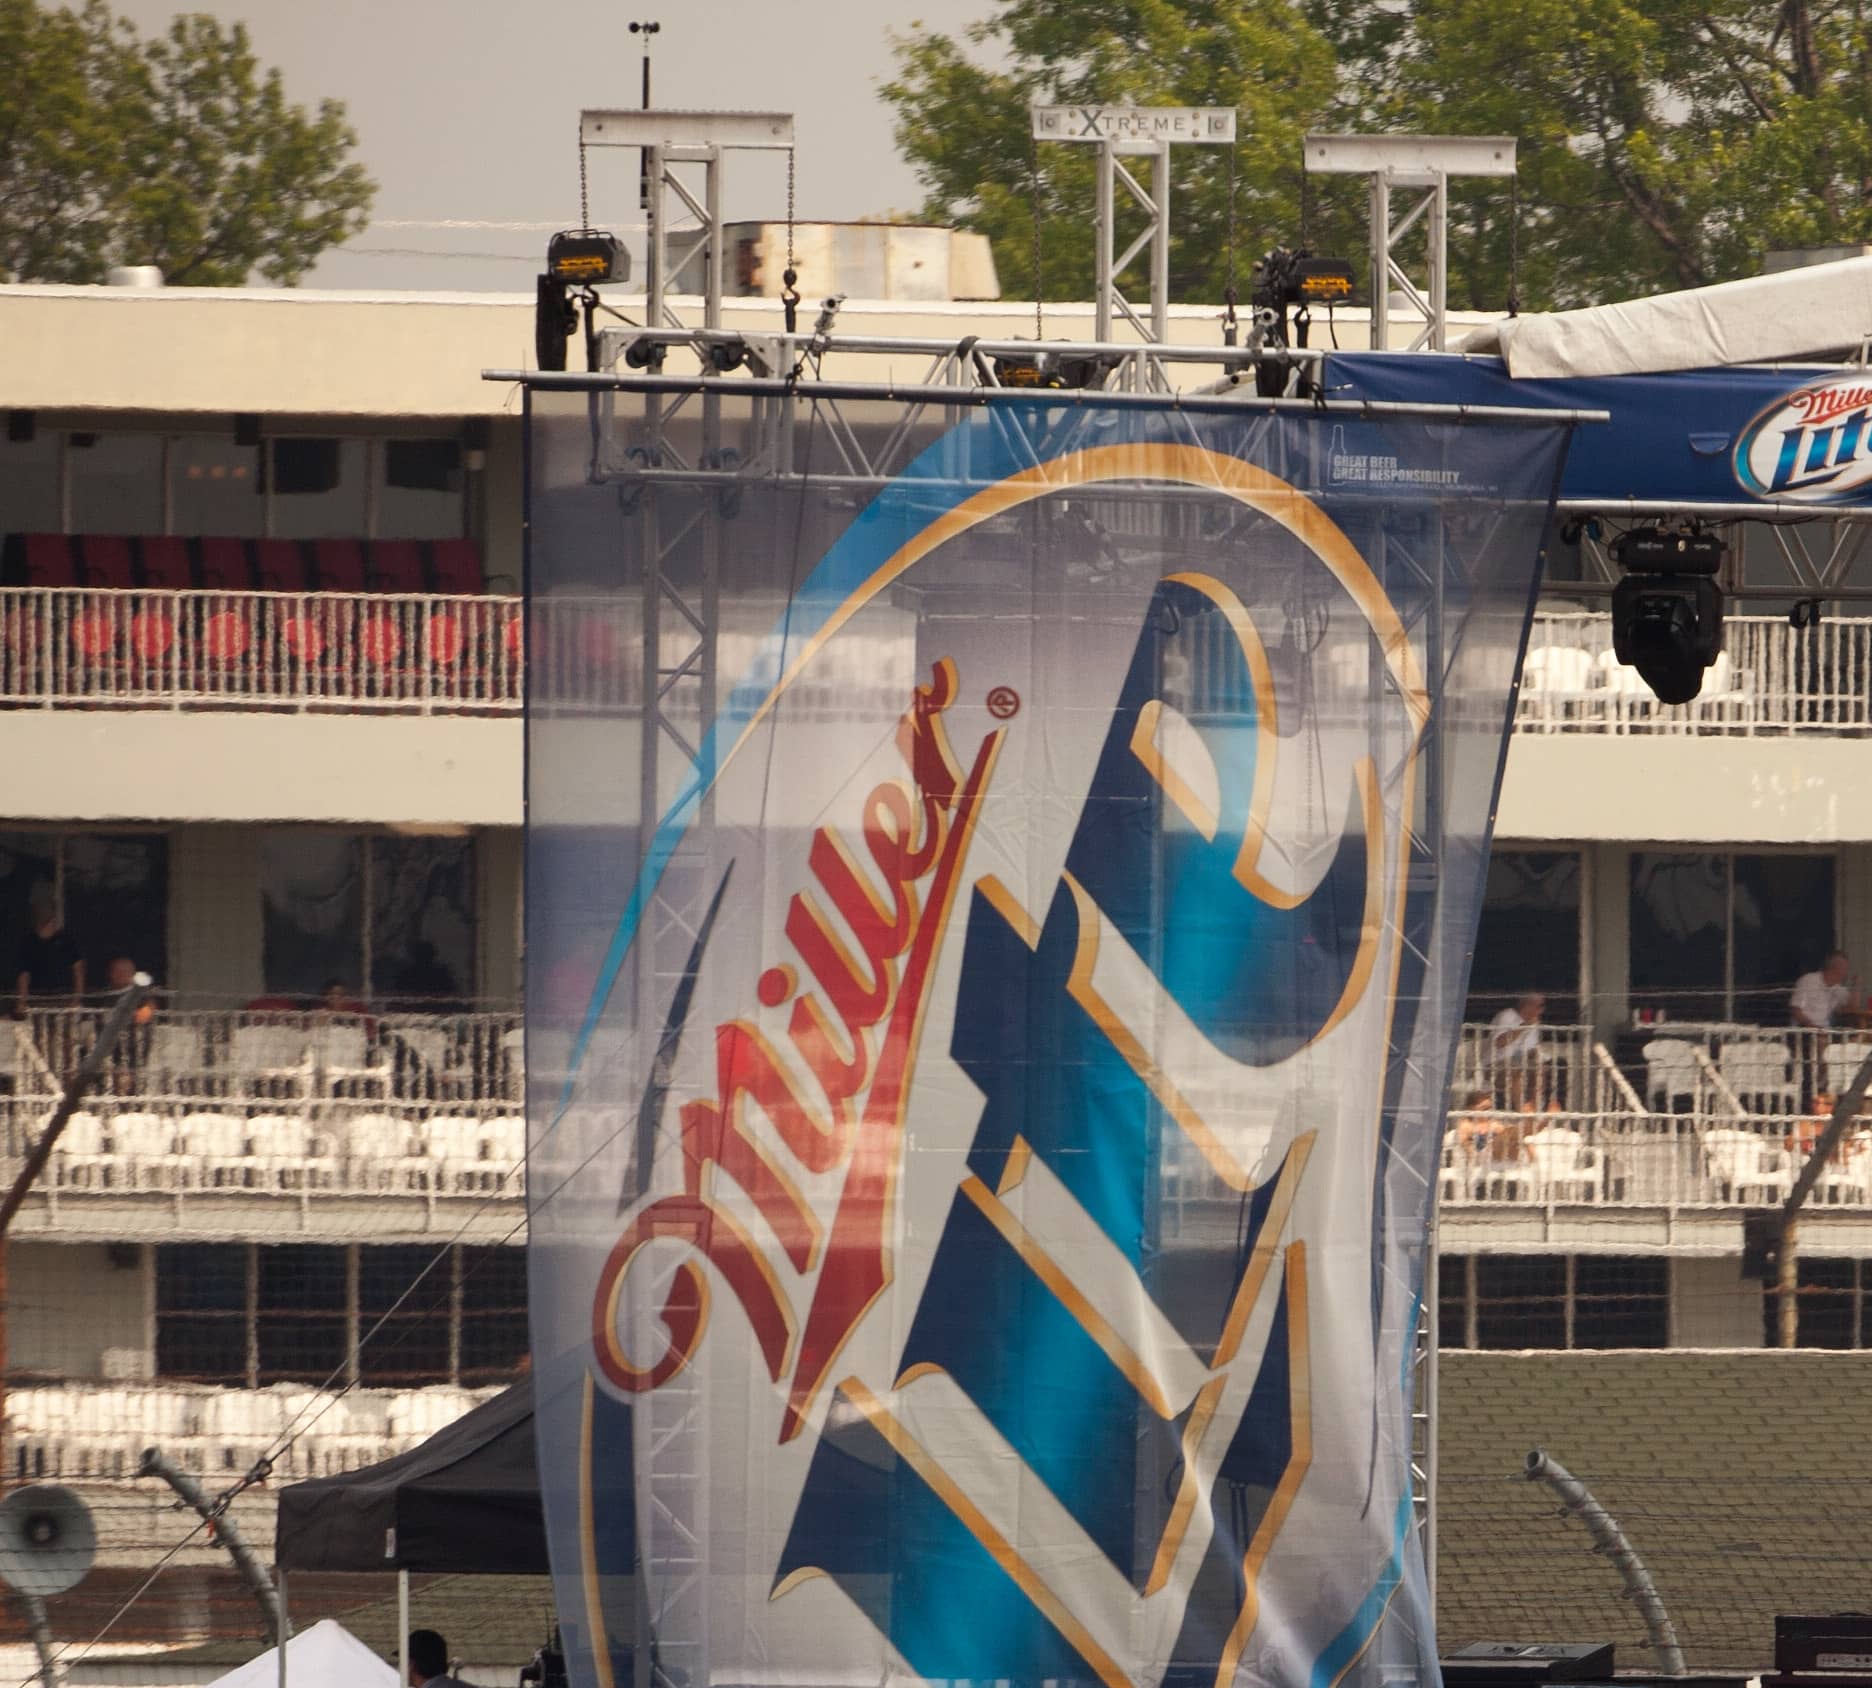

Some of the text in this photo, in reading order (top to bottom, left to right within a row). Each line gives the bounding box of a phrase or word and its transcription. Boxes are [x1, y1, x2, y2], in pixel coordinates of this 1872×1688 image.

[1080, 110, 1185, 136] XTREME
[1334, 455, 1397, 469] GREAT BEER
[1332, 467, 1460, 484] GREAT RESPONSIBILITY
